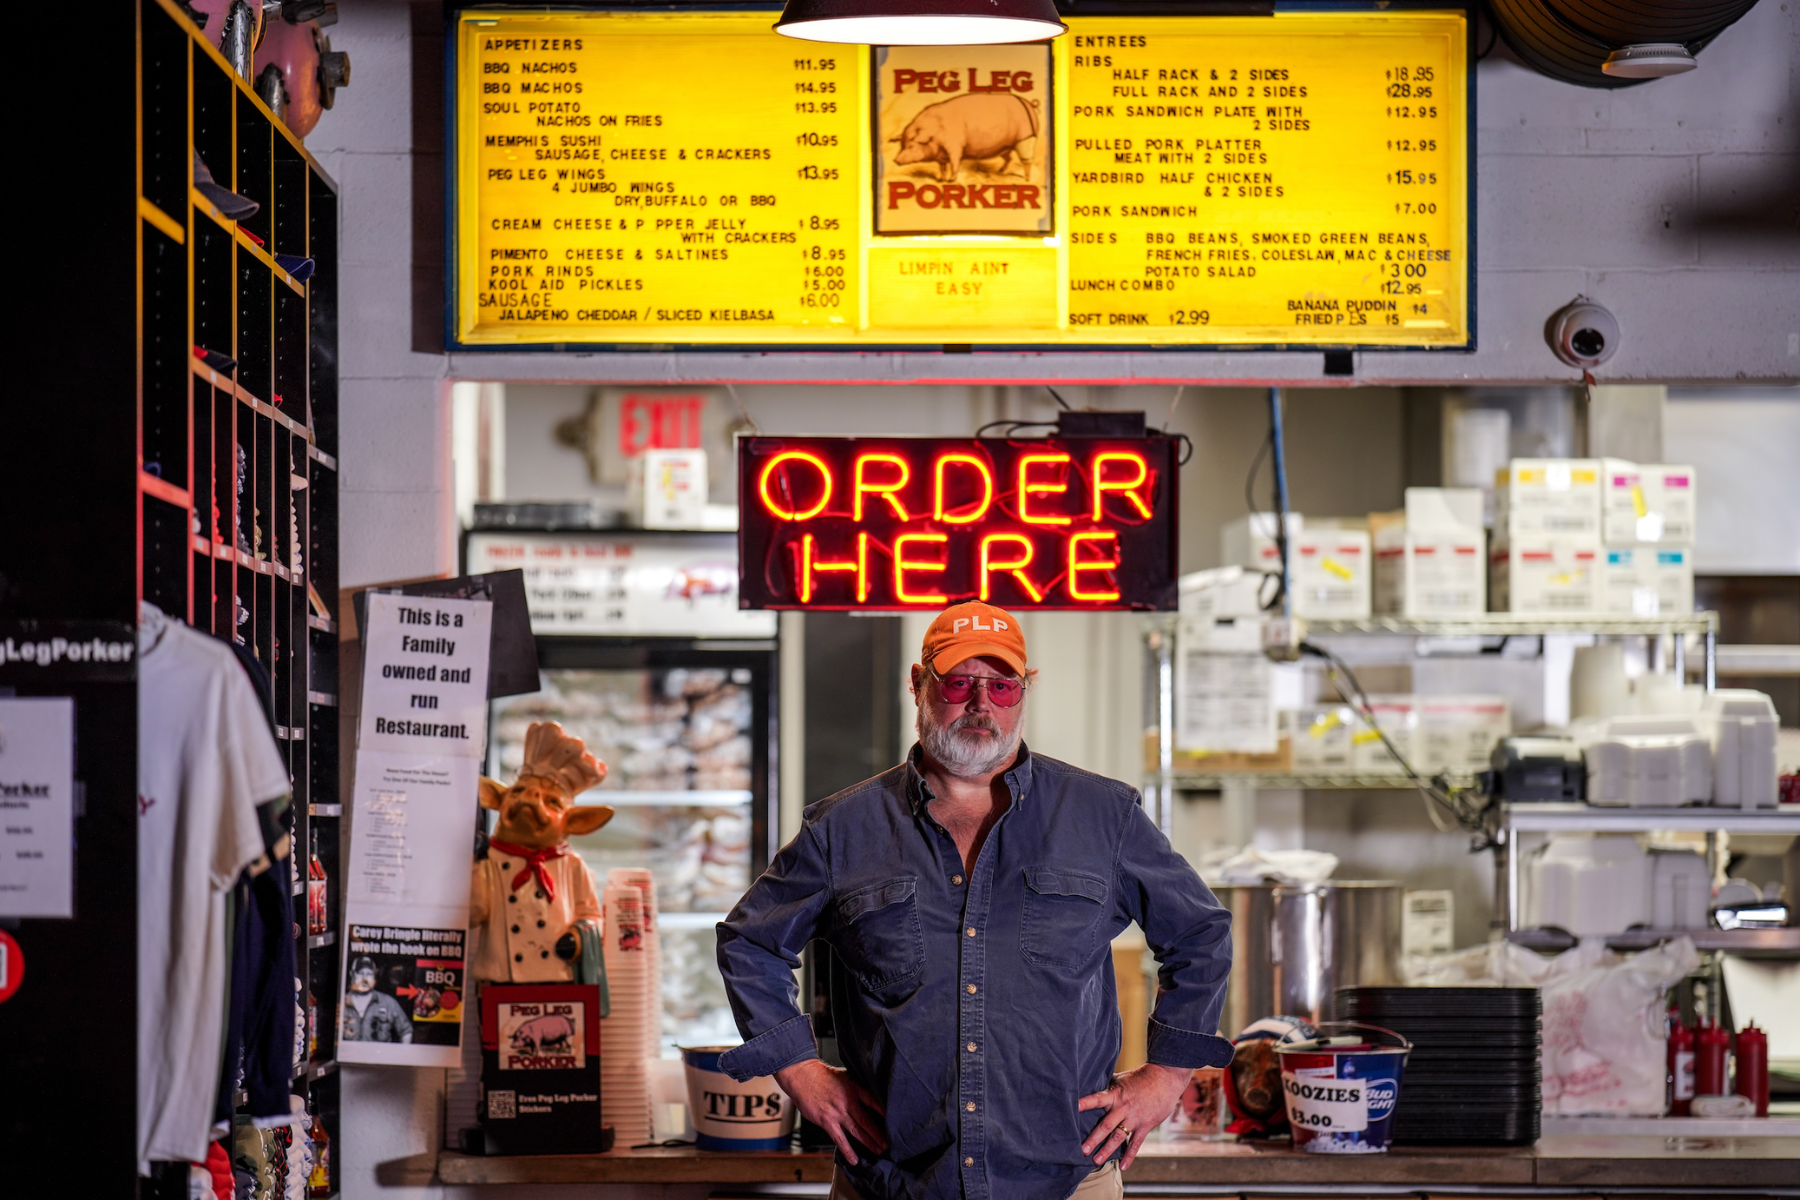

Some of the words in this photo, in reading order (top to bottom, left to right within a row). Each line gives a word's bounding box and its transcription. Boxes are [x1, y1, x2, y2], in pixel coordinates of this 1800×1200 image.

[485, 39, 582, 51] APPETIZERS
[1075, 36, 1146, 47] ENTREES
[794, 59, 835, 70] $11.95
[1075, 56, 1112, 67] RIBS
[484, 62, 510, 74] BBQ
[522, 62, 577, 73] NACHOS
[1386, 66, 1434, 81] $18.95
[1113, 69, 1148, 80] HALF
[1159, 69, 1198, 80] RACK
[1210, 69, 1218, 80] &
[1230, 69, 1237, 80] 2
[1250, 69, 1288, 80] SIDES
[893, 69, 960, 93] PEG
[969, 68, 1033, 92] LEG
[483, 82, 511, 94] BBQ
[521, 82, 582, 93] MACHOS
[796, 82, 836, 93] $14.95
[1113, 86, 1148, 97] FULL
[1159, 86, 1198, 97] RACK
[1209, 86, 1237, 97] AND
[1248, 86, 1254, 97] 2
[1263, 86, 1307, 97] SIDES
[1387, 83, 1432, 98] $28.95
[483, 102, 520, 114] SOUL
[529, 102, 580, 113] POTATO
[796, 102, 836, 113] $13.95
[1075, 106, 1113, 116] PORK
[1127, 106, 1202, 117] SANDWICH
[1215, 106, 1255, 117] PLATE
[1267, 106, 1301, 117] WITH
[1387, 107, 1437, 118] $12.95
[537, 116, 590, 126] NACHOS
[600, 116, 616, 126] ON
[625, 115, 662, 126] FRIES
[1254, 120, 1260, 130] 2
[1269, 120, 1309, 130] SIDES
[485, 136, 548, 147] MEMPHIS
[560, 135, 601, 147] SUSHI
[1076, 139, 1132, 150] PULLED
[1146, 139, 1183, 150] PORK
[1197, 139, 1260, 150] PLATTER
[1387, 140, 1436, 151] $12.95
[611, 149, 666, 160] CHEESE
[679, 149, 686, 160] &
[696, 149, 770, 159] CRACKERS
[1115, 153, 1151, 163] MEAT
[1159, 153, 1193, 163] WITH
[1205, 153, 1211, 163] 2
[1224, 153, 1267, 164] SIDES
[488, 169, 512, 180] PEG
[520, 169, 547, 180] LEG
[557, 169, 605, 179] WINGS
[798, 165, 838, 179] $13.95
[1073, 172, 1144, 183] YARDBIRD
[1161, 173, 1194, 183] HALF
[1207, 173, 1271, 183] CHICKEN
[1388, 170, 1436, 184] $15.95
[553, 183, 559, 192] 4
[571, 182, 616, 193] JUMBO
[631, 182, 674, 193] WINGS
[1205, 186, 1212, 197] &
[1223, 186, 1229, 197] 2
[1238, 186, 1283, 197] SIDES
[720, 195, 737, 206] OR
[751, 195, 776, 206] BBQ
[888, 182, 1041, 209] PORKER
[1073, 206, 1110, 216] PORK
[1121, 206, 1196, 216] SANDWICH
[1396, 203, 1436, 214] $7.00
[492, 219, 541, 230] CREAM
[554, 219, 611, 230] CHEESE
[620, 219, 626, 229] &
[705, 219, 745, 229] JELLY
[682, 233, 713, 242] WITH
[725, 233, 796, 243] CRACKERS
[1071, 233, 1116, 243] SIDES
[1147, 233, 1174, 244] BBQ
[1252, 233, 1310, 243] SMOKED
[1320, 233, 1367, 243] GREEN
[491, 249, 547, 260] PIMENTO
[566, 249, 623, 260] CHEESE
[635, 249, 642, 260] &
[656, 249, 727, 260] SALTINES
[1147, 250, 1201, 260] FRENCH
[1345, 250, 1376, 260] MAC
[491, 266, 533, 277] PORK
[546, 266, 593, 276] RINDS
[899, 262, 953, 275] LIMPIN
[971, 262, 1009, 275] AINT
[1146, 266, 1199, 277] POTATO
[1208, 267, 1255, 277] SALAD
[489, 279, 527, 290] KOOL
[540, 279, 564, 290] AID
[580, 279, 642, 290] PICKLES
[936, 282, 982, 295] EASY
[1381, 280, 1421, 294] $12.95
[479, 293, 551, 307] SAUSAGE
[1288, 300, 1339, 310] BANANA
[499, 309, 568, 321] JALAPENO
[577, 310, 637, 321] CHEDDAR
[657, 310, 702, 321] SLICED
[711, 310, 774, 320] KIELBASA
[1069, 313, 1102, 325] SOFT
[1109, 314, 1148, 324] DRINK
[1170, 310, 1209, 325] $2.99
[758, 450, 1152, 525] ORDER
[800, 531, 1121, 604] HERE
[398, 607, 431, 625] This
[436, 610, 450, 627] is
[454, 614, 463, 627] a
[953, 615, 1008, 635] PLP
[402, 636, 455, 656] Family
[383, 664, 436, 681] owned
[441, 668, 471, 683] and
[411, 695, 438, 709] run
[376, 718, 469, 739] Restaurant.
[353, 926, 383, 939] Carey
[384, 928, 421, 941] Bringle
[422, 930, 462, 943] literally
[351, 942, 380, 953] wrote
[382, 942, 398, 954] the
[400, 943, 425, 956] book
[427, 946, 439, 955] on
[441, 946, 462, 957] BBQ
[425, 971, 455, 986] BBQ
[510, 1005, 540, 1016] PEG
[544, 1005, 572, 1015] LEG
[508, 1056, 576, 1069] PORKER
[1367, 1089, 1393, 1099] BUD
